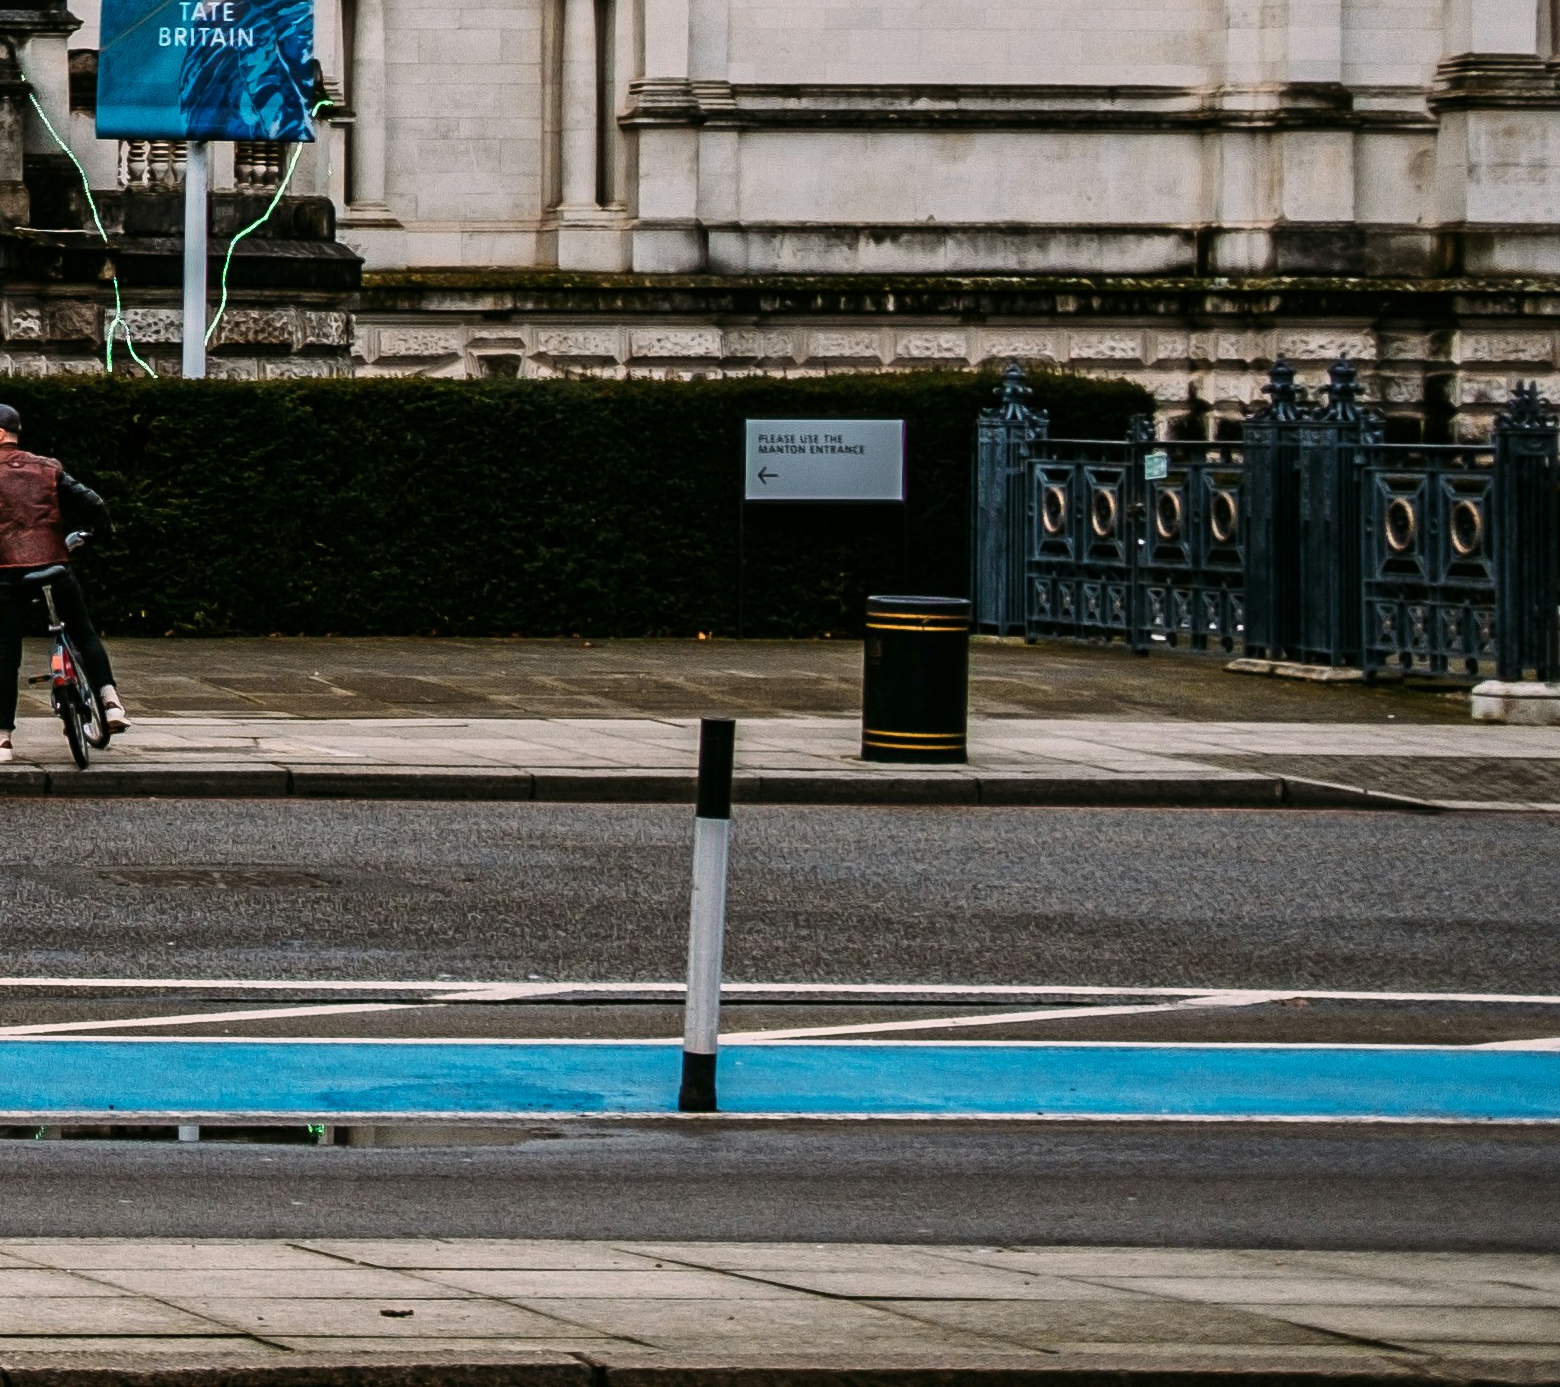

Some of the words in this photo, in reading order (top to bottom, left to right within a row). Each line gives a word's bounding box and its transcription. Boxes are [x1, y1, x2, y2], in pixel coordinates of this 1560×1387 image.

[179, 1, 235, 22] TATE
[159, 27, 254, 47] BRITAIN
[759, 433, 795, 444] PLEASE
[824, 434, 843, 444] THE
[759, 445, 805, 454] MANTON
[810, 445, 865, 455] ENTRANCE
